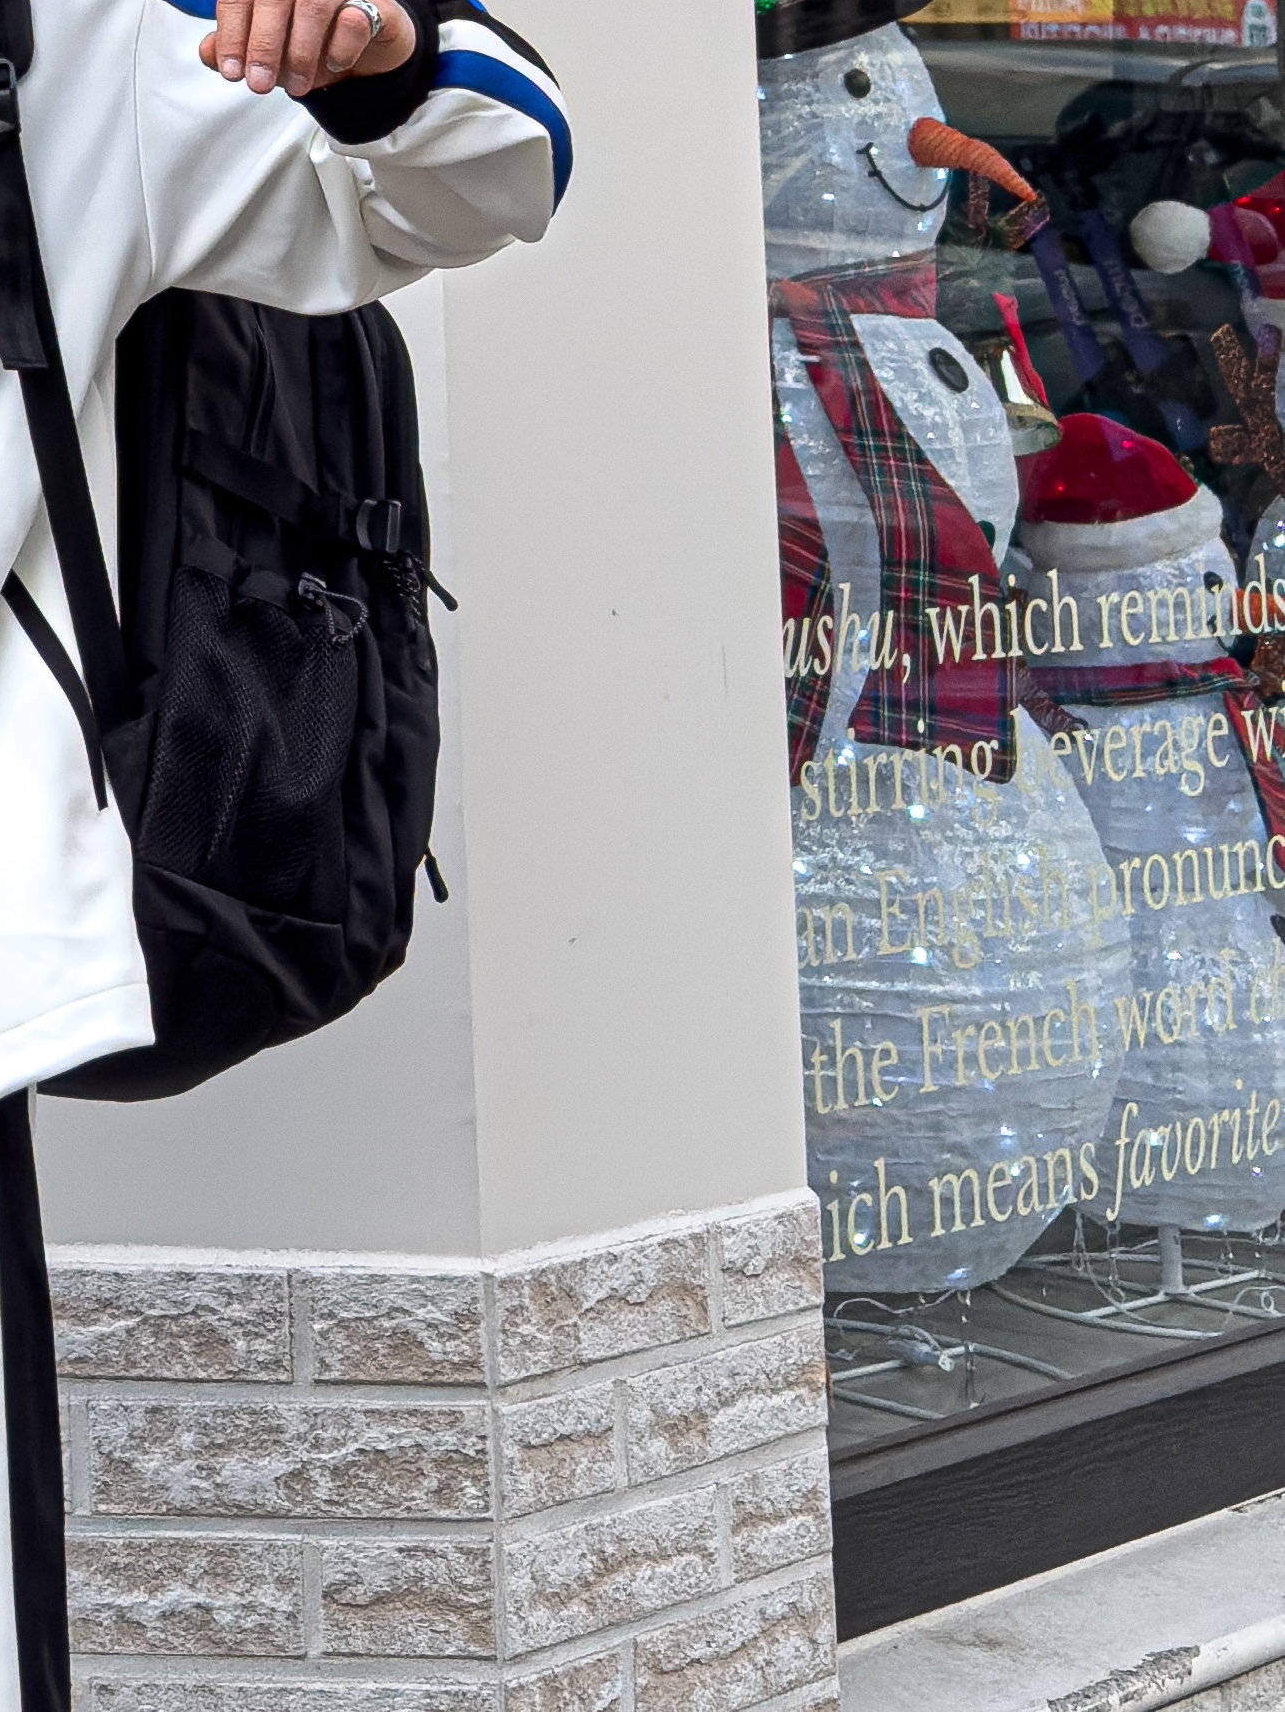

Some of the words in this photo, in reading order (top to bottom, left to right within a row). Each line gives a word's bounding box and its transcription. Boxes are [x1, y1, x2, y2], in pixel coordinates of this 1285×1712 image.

[925, 568, 1085, 665] which
[1096, 552, 1285, 649] reminds
[799, 717, 1002, 827] stirring
[1009, 705, 1231, 798] beverage
[876, 843, 1069, 970] English
[1086, 833, 1285, 950] pronunc
[810, 1018, 901, 1116] the
[915, 979, 1102, 1095] French
[1114, 946, 1238, 1053] word
[822, 1156, 914, 1264] ich
[929, 1139, 1100, 1239] means
[1105, 1077, 1281, 1222] favorite
